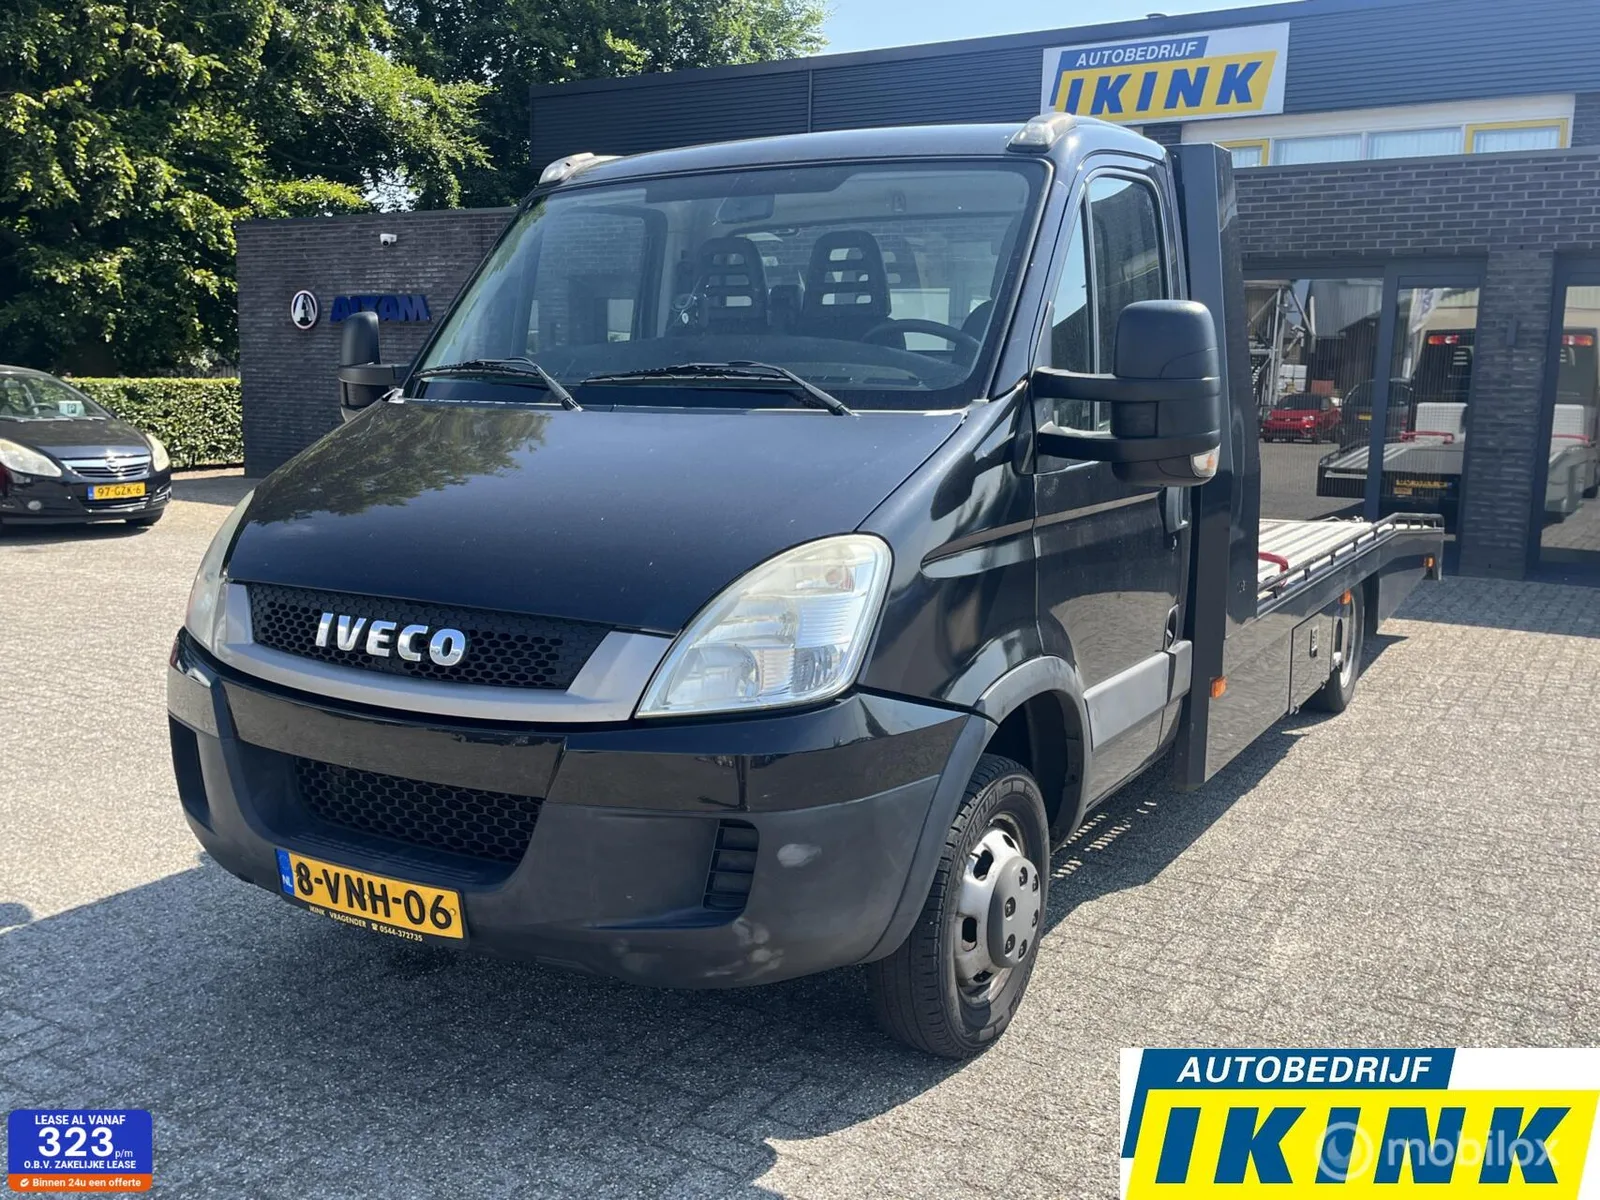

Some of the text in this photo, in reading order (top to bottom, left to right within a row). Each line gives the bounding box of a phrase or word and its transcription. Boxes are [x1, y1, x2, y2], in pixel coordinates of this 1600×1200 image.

[1075, 41, 1199, 68] AUTOBEDRIJF
[1064, 61, 1263, 115] IKINK
[97, 485, 141, 497] 97-GZK-6
[315, 612, 466, 667] IVECO
[281, 873, 293, 888] NL
[295, 861, 452, 930] 8-VNH-06
[329, 911, 367, 928] VRAGENDER
[379, 925, 423, 942] 0544-372735
